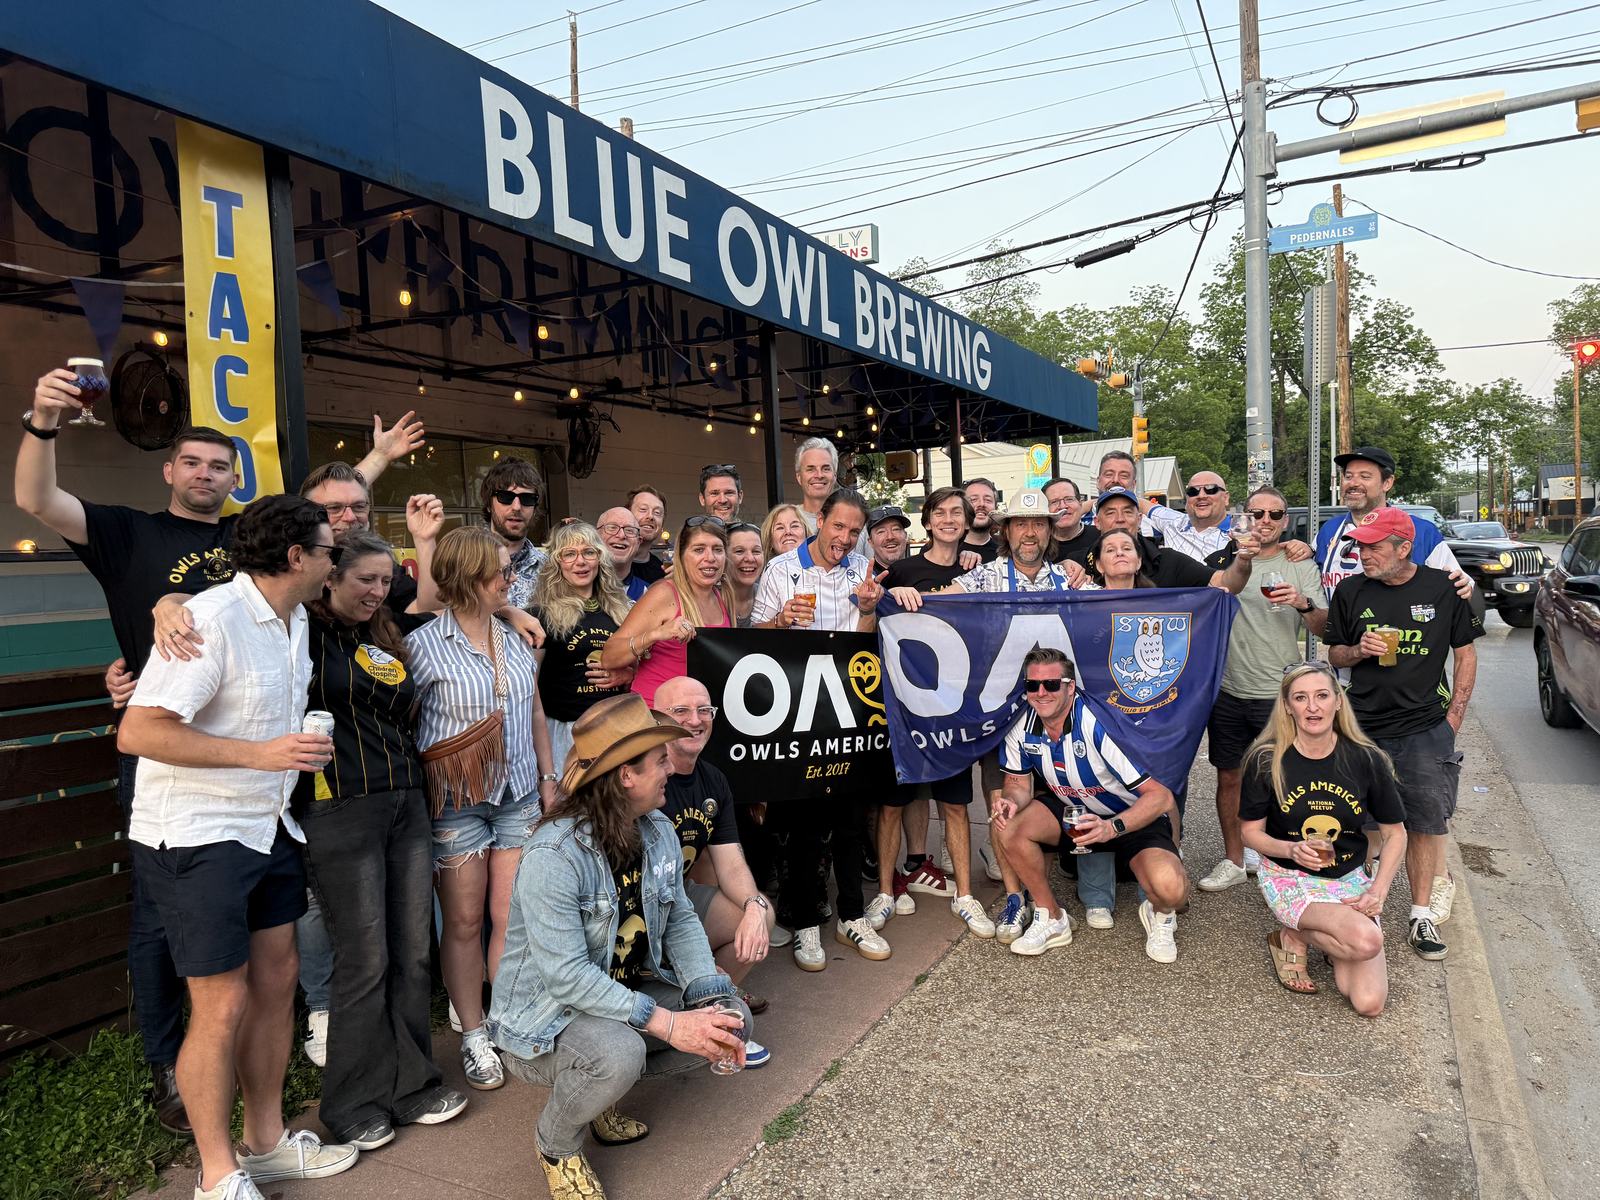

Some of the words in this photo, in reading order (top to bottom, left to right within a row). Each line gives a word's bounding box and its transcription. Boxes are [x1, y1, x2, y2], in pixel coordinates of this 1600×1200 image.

[480, 77, 691, 283] BLUE
[718, 206, 840, 338] OWL
[854, 269, 991, 391] BREWING
[817, 230, 862, 249] LLY
[1290, 226, 1354, 244] PEDERNALES
[169, 553, 201, 583] OWLS
[567, 630, 587, 651] OWLS
[910, 719, 996, 749] OWLS
[729, 741, 800, 761] OWLS
[805, 765, 823, 779] Est.
[826, 762, 851, 777] 2017
[1281, 785, 1306, 812] OWLS
[1310, 780, 1362, 815] AMERICAS
[684, 807, 714, 841] AMERICA
